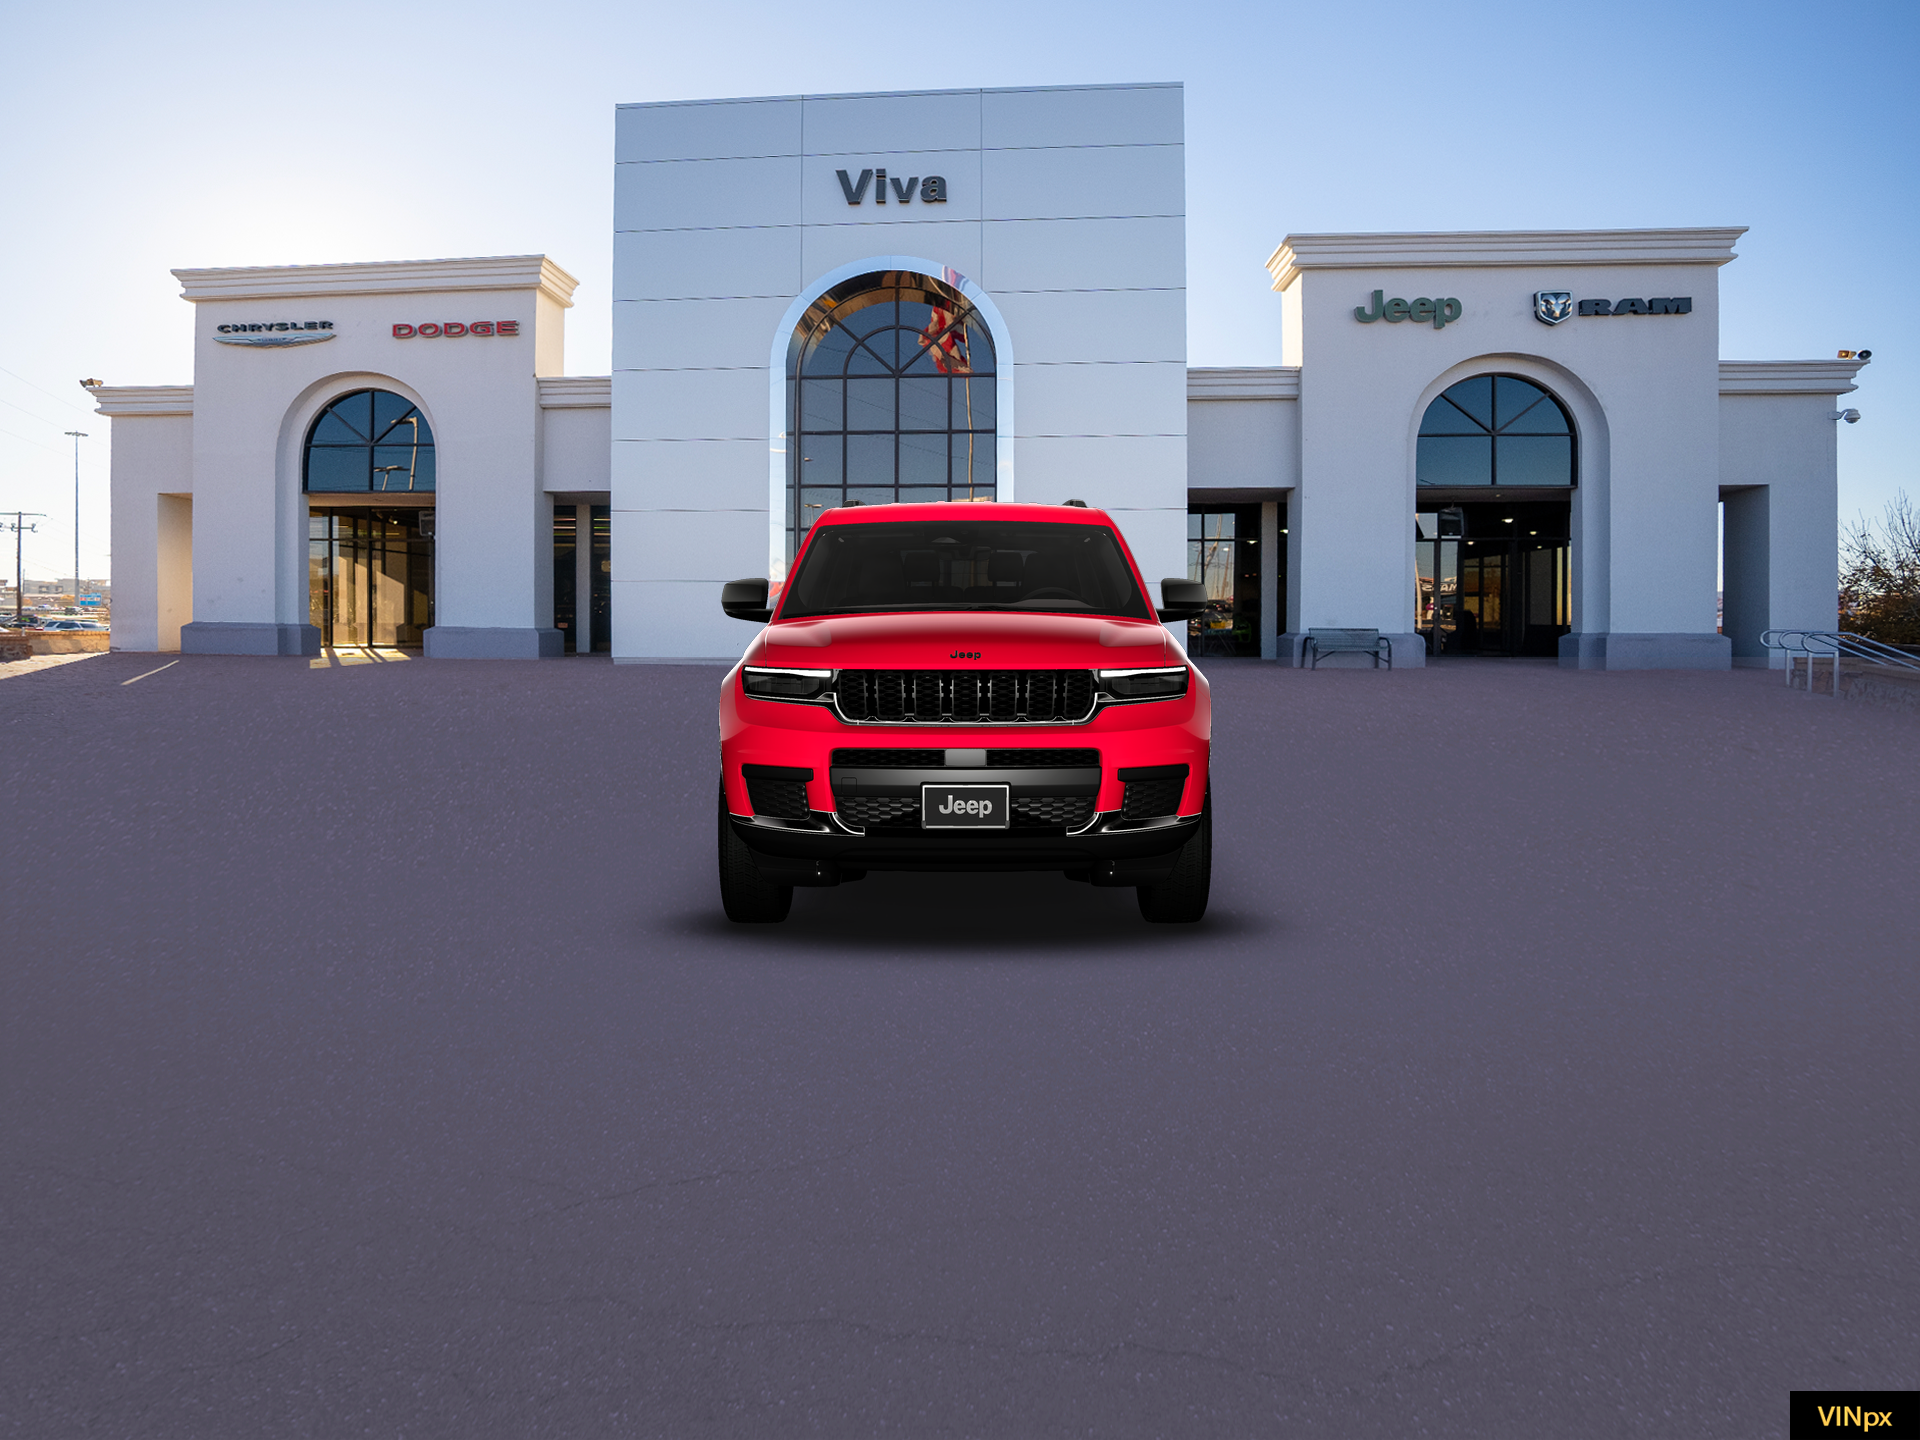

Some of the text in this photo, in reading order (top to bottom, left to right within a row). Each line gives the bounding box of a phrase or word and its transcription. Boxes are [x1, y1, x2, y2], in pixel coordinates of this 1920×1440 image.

[835, 168, 947, 205] Viva
[1354, 289, 1463, 329] Jeep
[1578, 296, 1692, 316] RAM
[217, 320, 334, 333] CHRYSLER
[392, 319, 520, 338] DODGE
[949, 650, 982, 660] Jeep
[938, 794, 993, 818] Jeep
